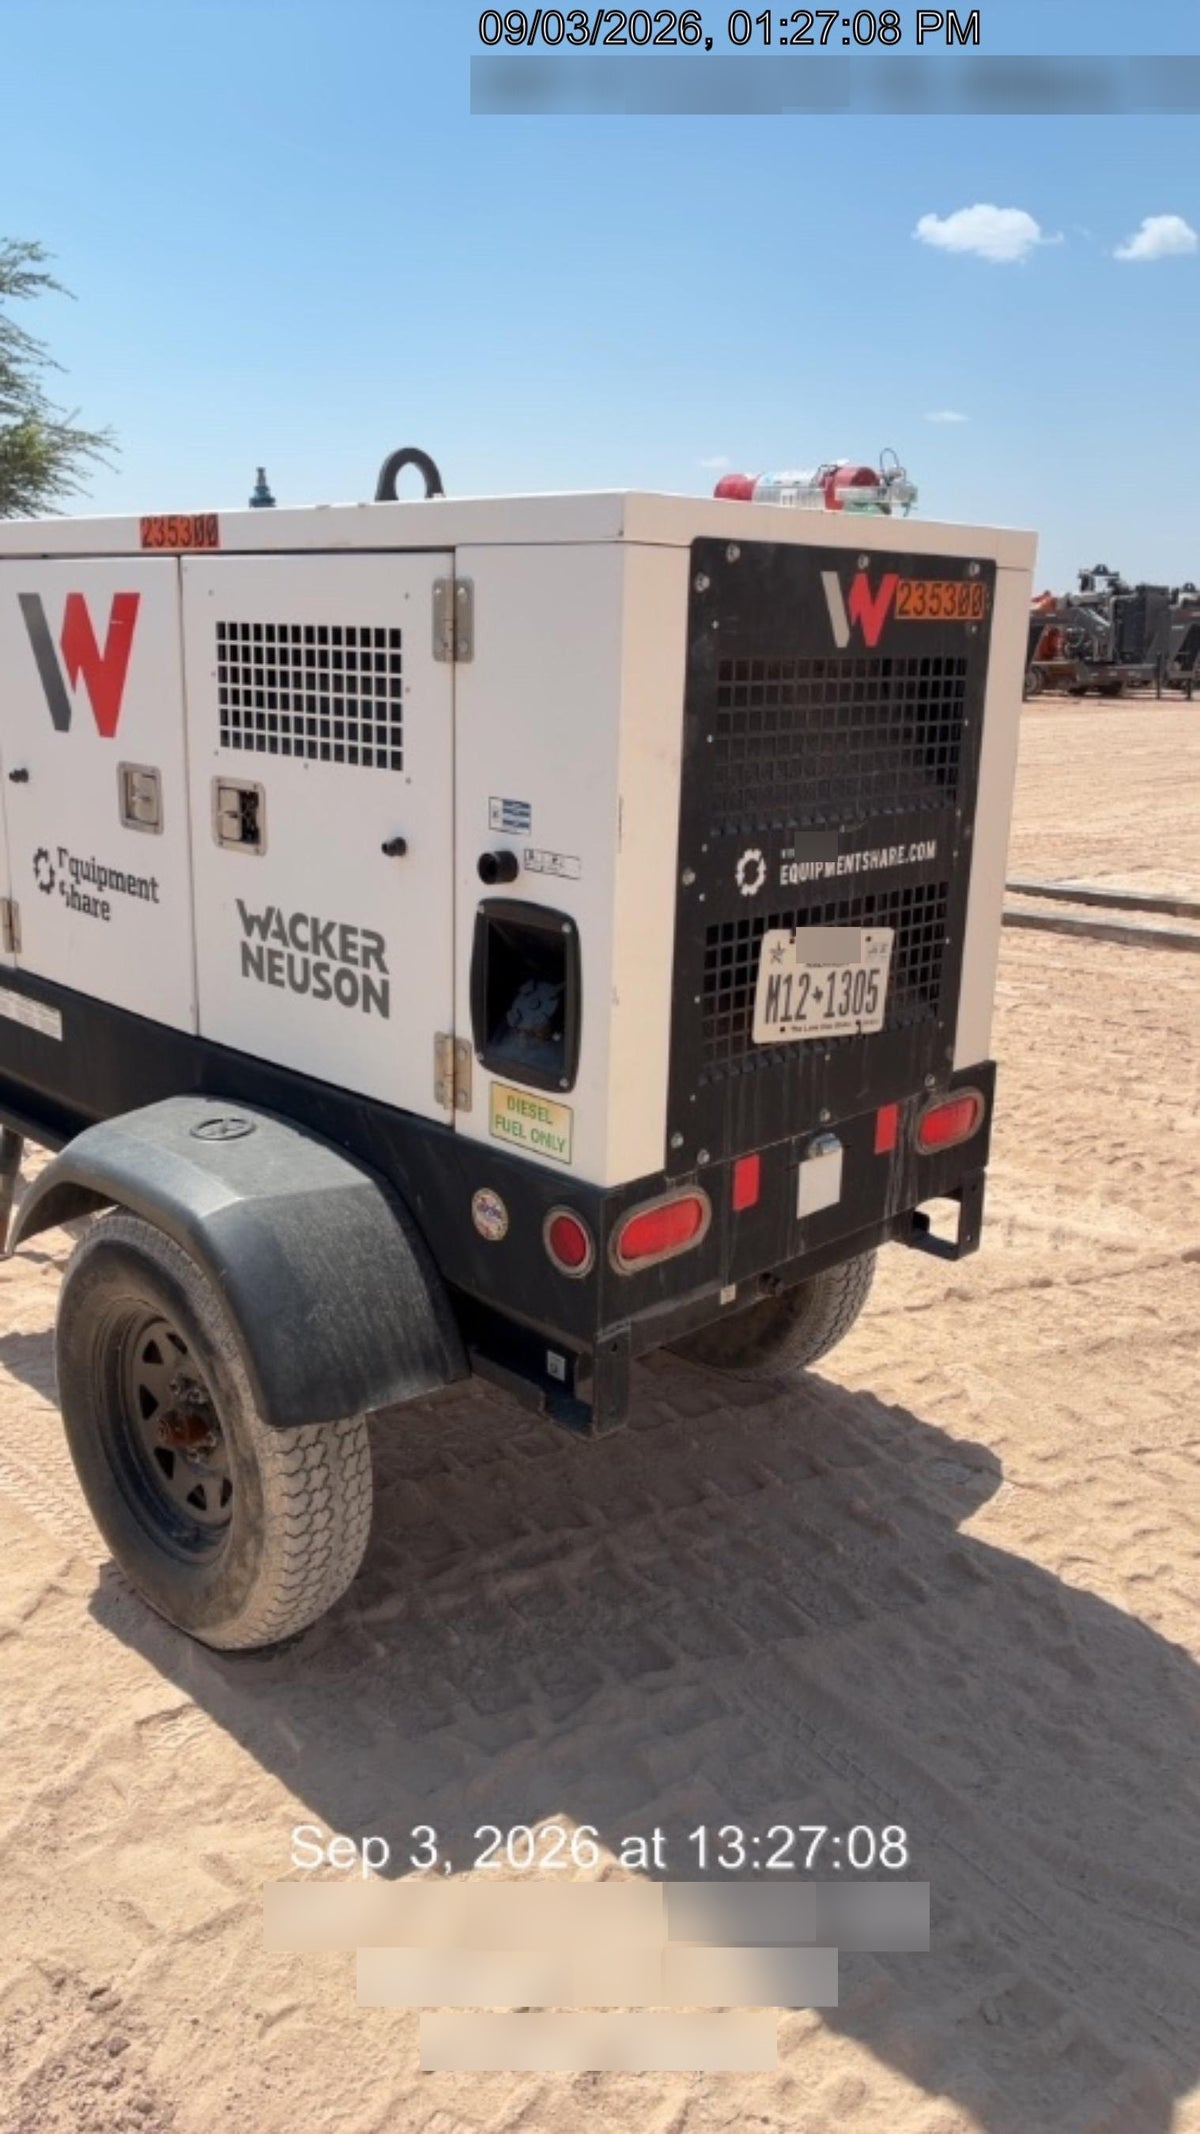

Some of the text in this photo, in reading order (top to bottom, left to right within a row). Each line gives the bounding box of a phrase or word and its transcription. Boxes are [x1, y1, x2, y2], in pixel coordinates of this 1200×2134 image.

[141, 514, 219, 548] 235300
[898, 582, 984, 617] 235300
[779, 840, 938, 886] EQUIPMENTSHARE.COM
[235, 898, 390, 975] WACKER
[240, 940, 390, 1020] NEUSON
[507, 1095, 553, 1125] DIESEL
[495, 1114, 566, 1153] FUEL ONLY
